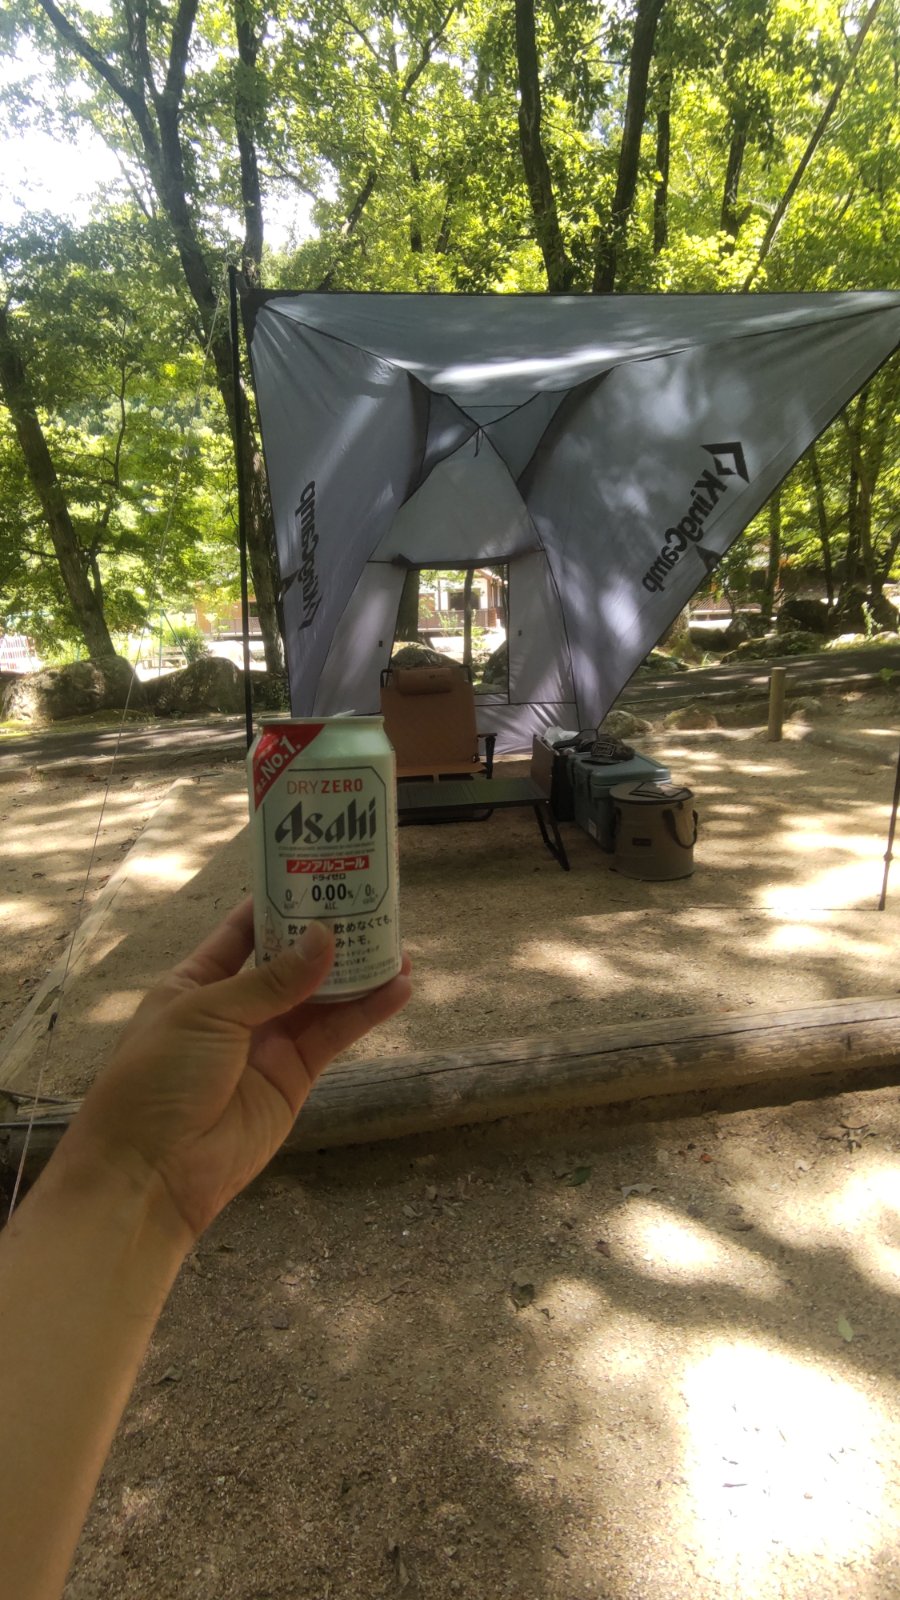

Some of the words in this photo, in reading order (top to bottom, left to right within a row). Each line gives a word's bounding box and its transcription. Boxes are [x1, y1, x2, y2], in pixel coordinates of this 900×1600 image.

[274, 796, 377, 844] Asahi
[290, 858, 366, 872] ノンアルコール
[312, 873, 346, 882] ドライゼロ
